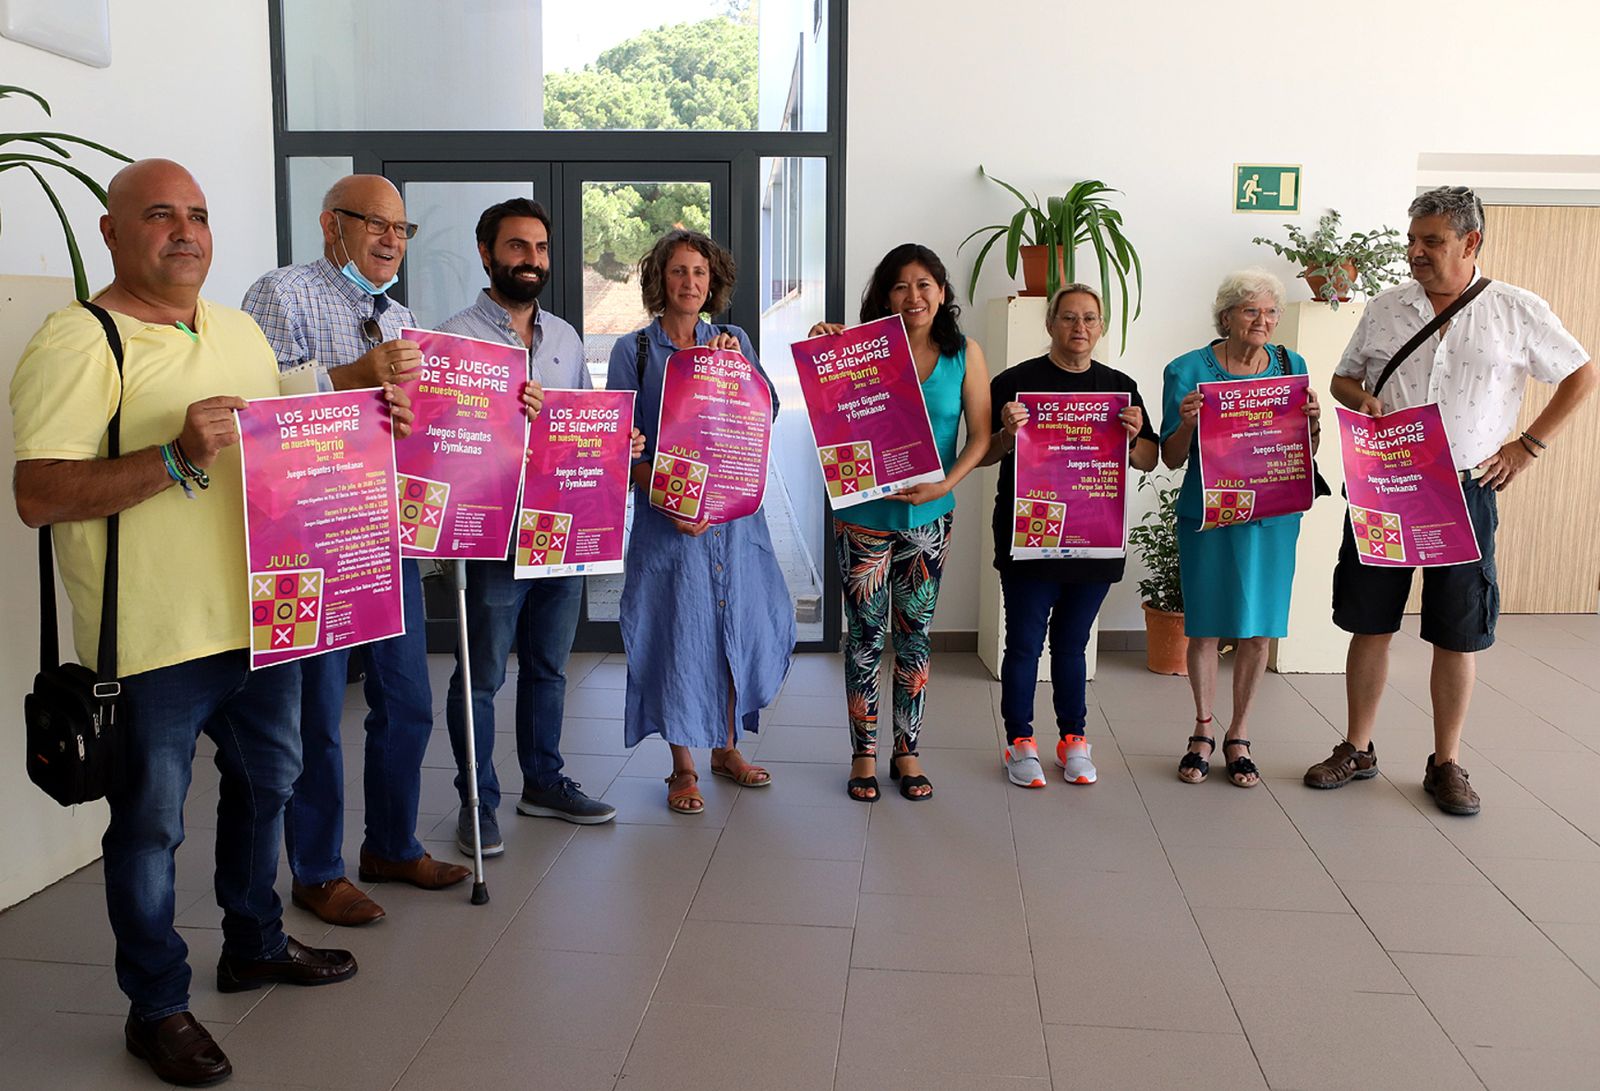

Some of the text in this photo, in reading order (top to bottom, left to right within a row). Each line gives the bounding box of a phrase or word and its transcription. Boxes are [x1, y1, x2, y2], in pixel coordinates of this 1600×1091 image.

[812, 336, 889, 365] LOS JUEGOS
[421, 354, 510, 378] LOS JUEGOS
[694, 355, 752, 372] LOS JUEGOS
[817, 347, 891, 375] DE SIEMPRE
[694, 365, 751, 381] DE SIEMPRE
[820, 364, 878, 384] en nuestro barrio
[420, 369, 508, 392] DE SIEMPRE
[717, 381, 738, 391] barrio
[419, 385, 489, 408] en nuestro barrio
[1219, 386, 1291, 400] LOS JUEGOS
[837, 391, 890, 412] Juegos Gigantes
[1037, 402, 1110, 411] LOS JUEGOS
[1221, 397, 1289, 410] DE SIEMPRE
[276, 405, 360, 425] LOS JUEGOS
[456, 409, 488, 419] Jerez 2022
[549, 409, 619, 419] LOS JUEGOS
[846, 404, 886, 423] y Gymkanas
[1038, 413, 1108, 421] DE SIEMPRE
[1248, 408, 1273, 420] barrio
[281, 419, 359, 439] DE SIEMPRE
[426, 424, 492, 442] Juegos Gigantes
[549, 421, 617, 432] DE SIEMPRE
[1066, 425, 1093, 434] barrio
[1351, 421, 1424, 440] LOS JUEGOS
[315, 436, 343, 452] barrio
[558, 434, 581, 442] nuestro
[577, 435, 602, 447] barrio
[1354, 432, 1425, 449] DE SIEMPRE
[433, 441, 482, 455] y Gymkanas
[1253, 443, 1303, 455] Juegos Gigantes
[1381, 448, 1410, 461] barrio
[554, 466, 604, 478] Juegos Gigantes
[1067, 460, 1119, 470] Juegos Gigantes
[559, 479, 597, 490] y Gymkanas
[1368, 474, 1423, 485] Juegos Gigantes
[1375, 484, 1418, 494] y Gymkanas
